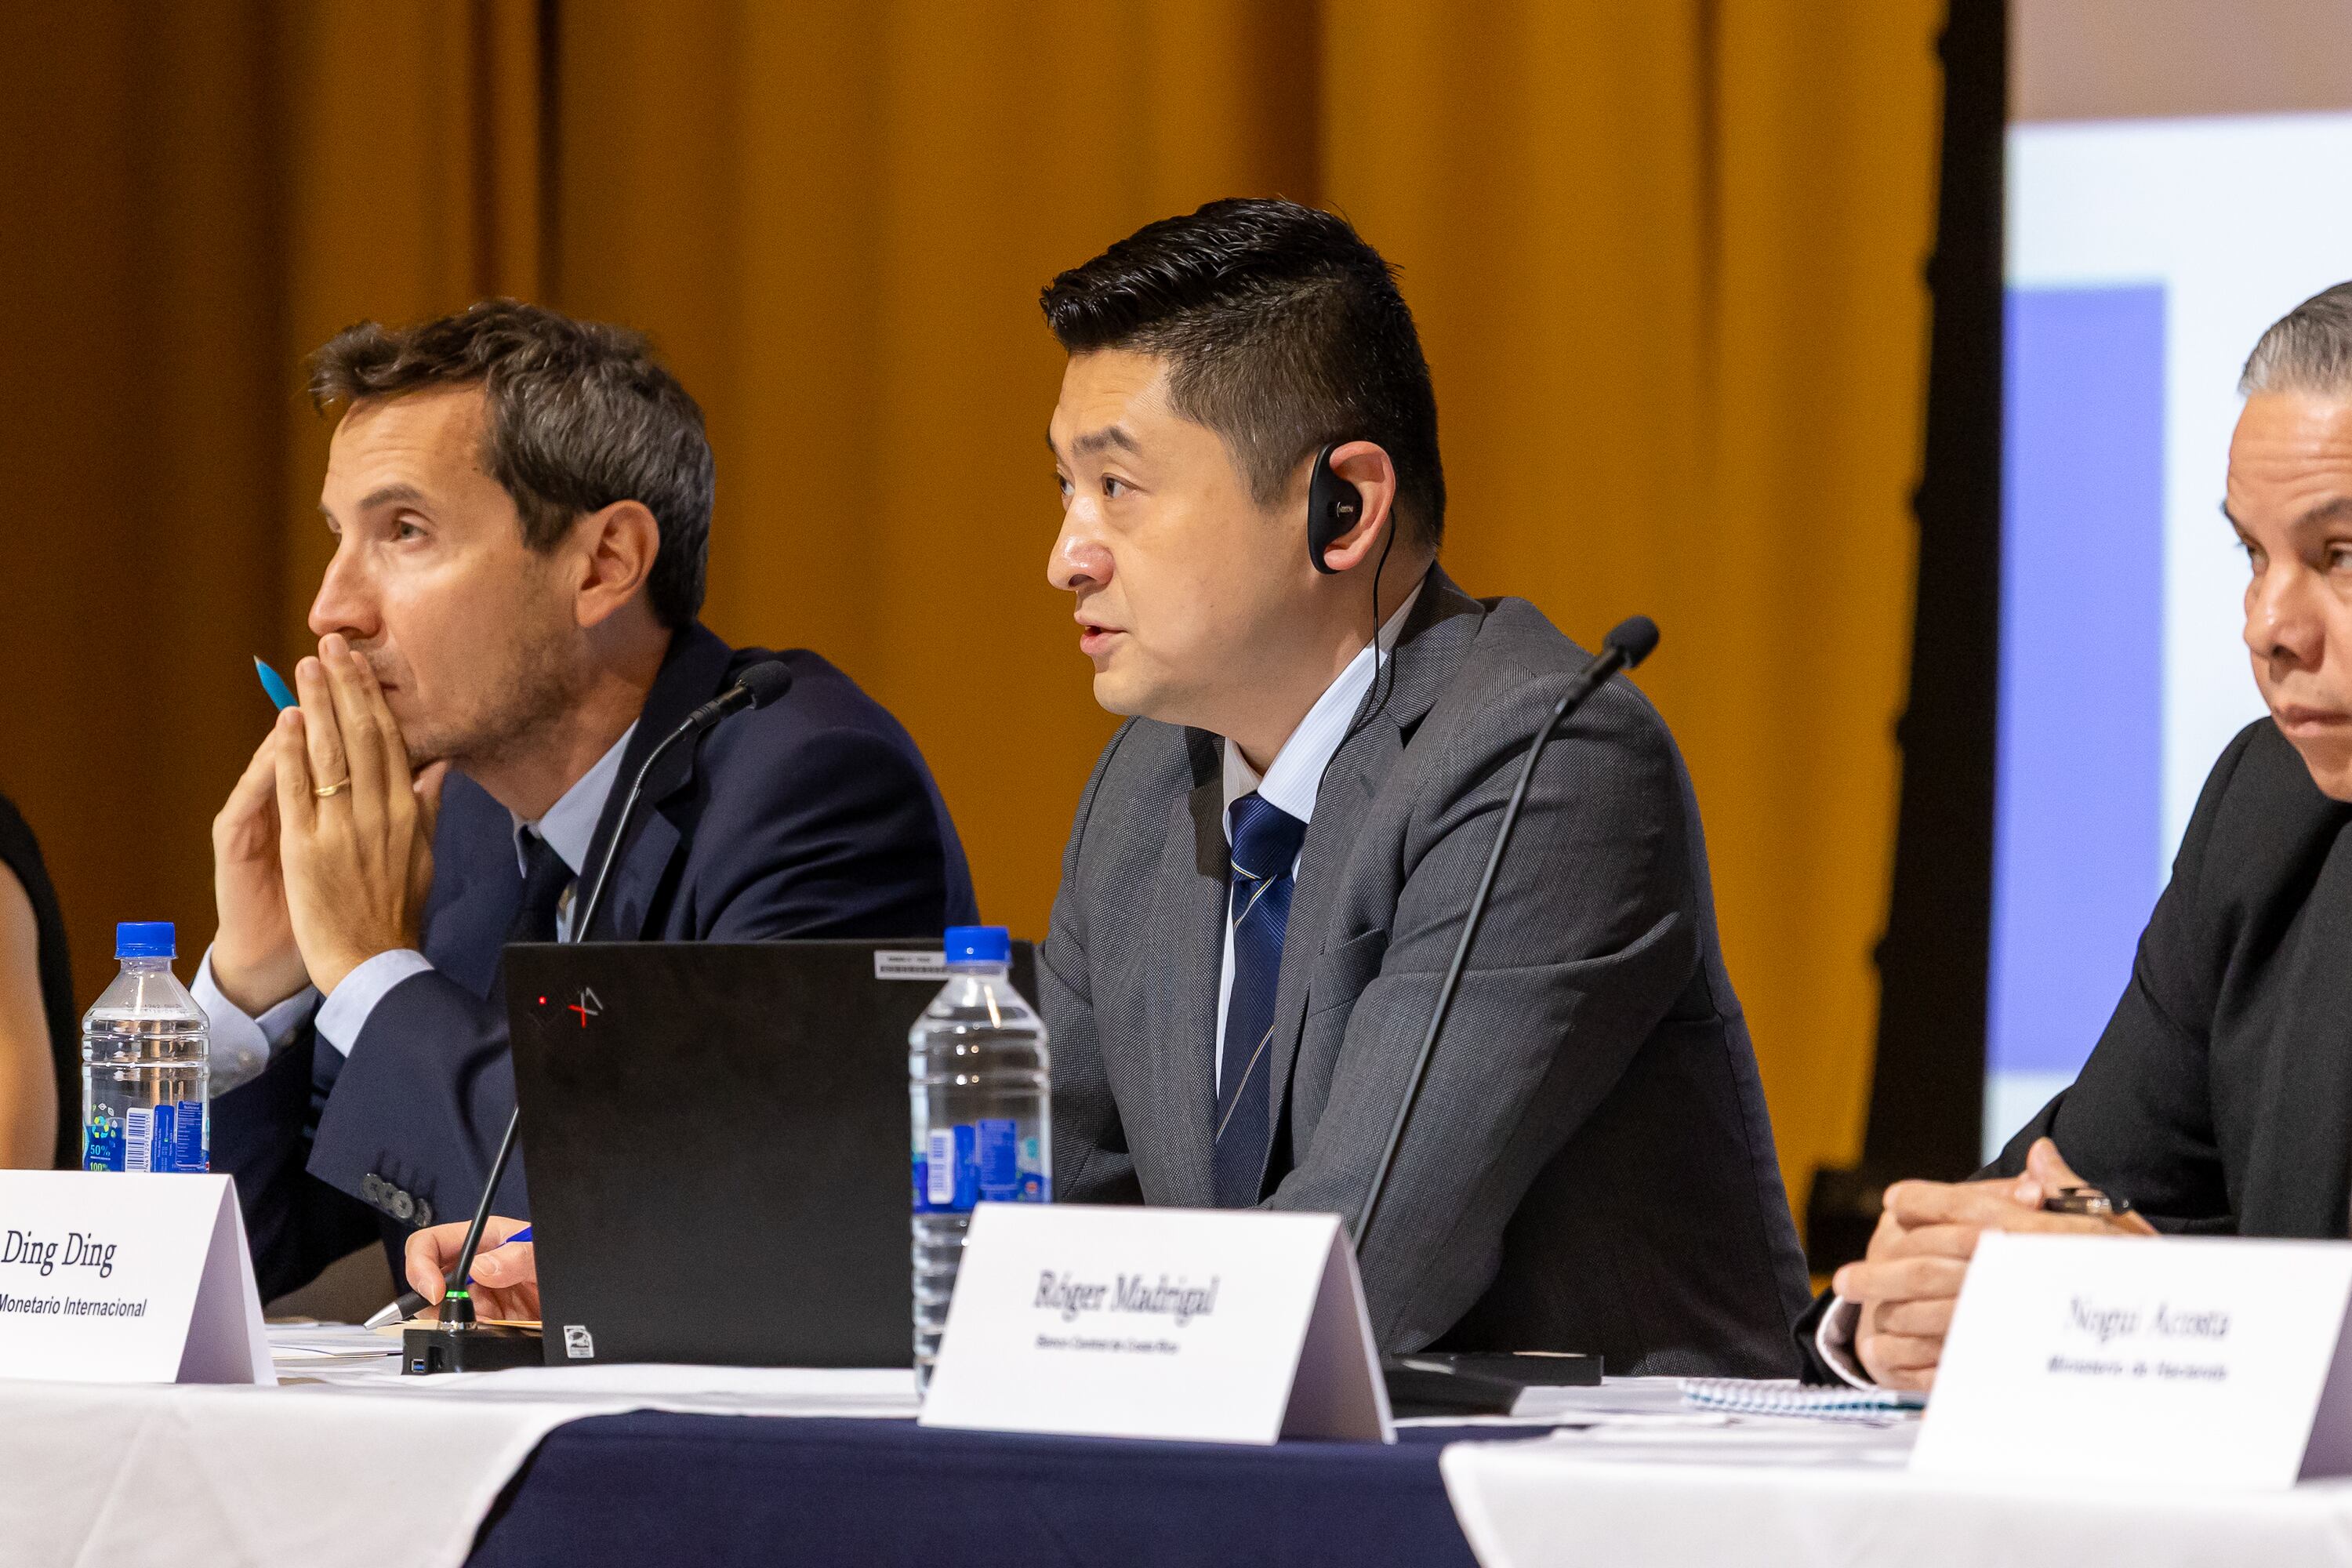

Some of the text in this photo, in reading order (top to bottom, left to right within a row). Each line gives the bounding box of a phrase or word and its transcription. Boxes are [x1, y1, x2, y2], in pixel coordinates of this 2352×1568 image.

[90, 1145, 111, 1156] 50%
[1, 1229, 118, 1278] Ding Ding
[0, 1293, 147, 1317] Monetario Internacional
[1109, 1273, 1221, 1328] Madrigal
